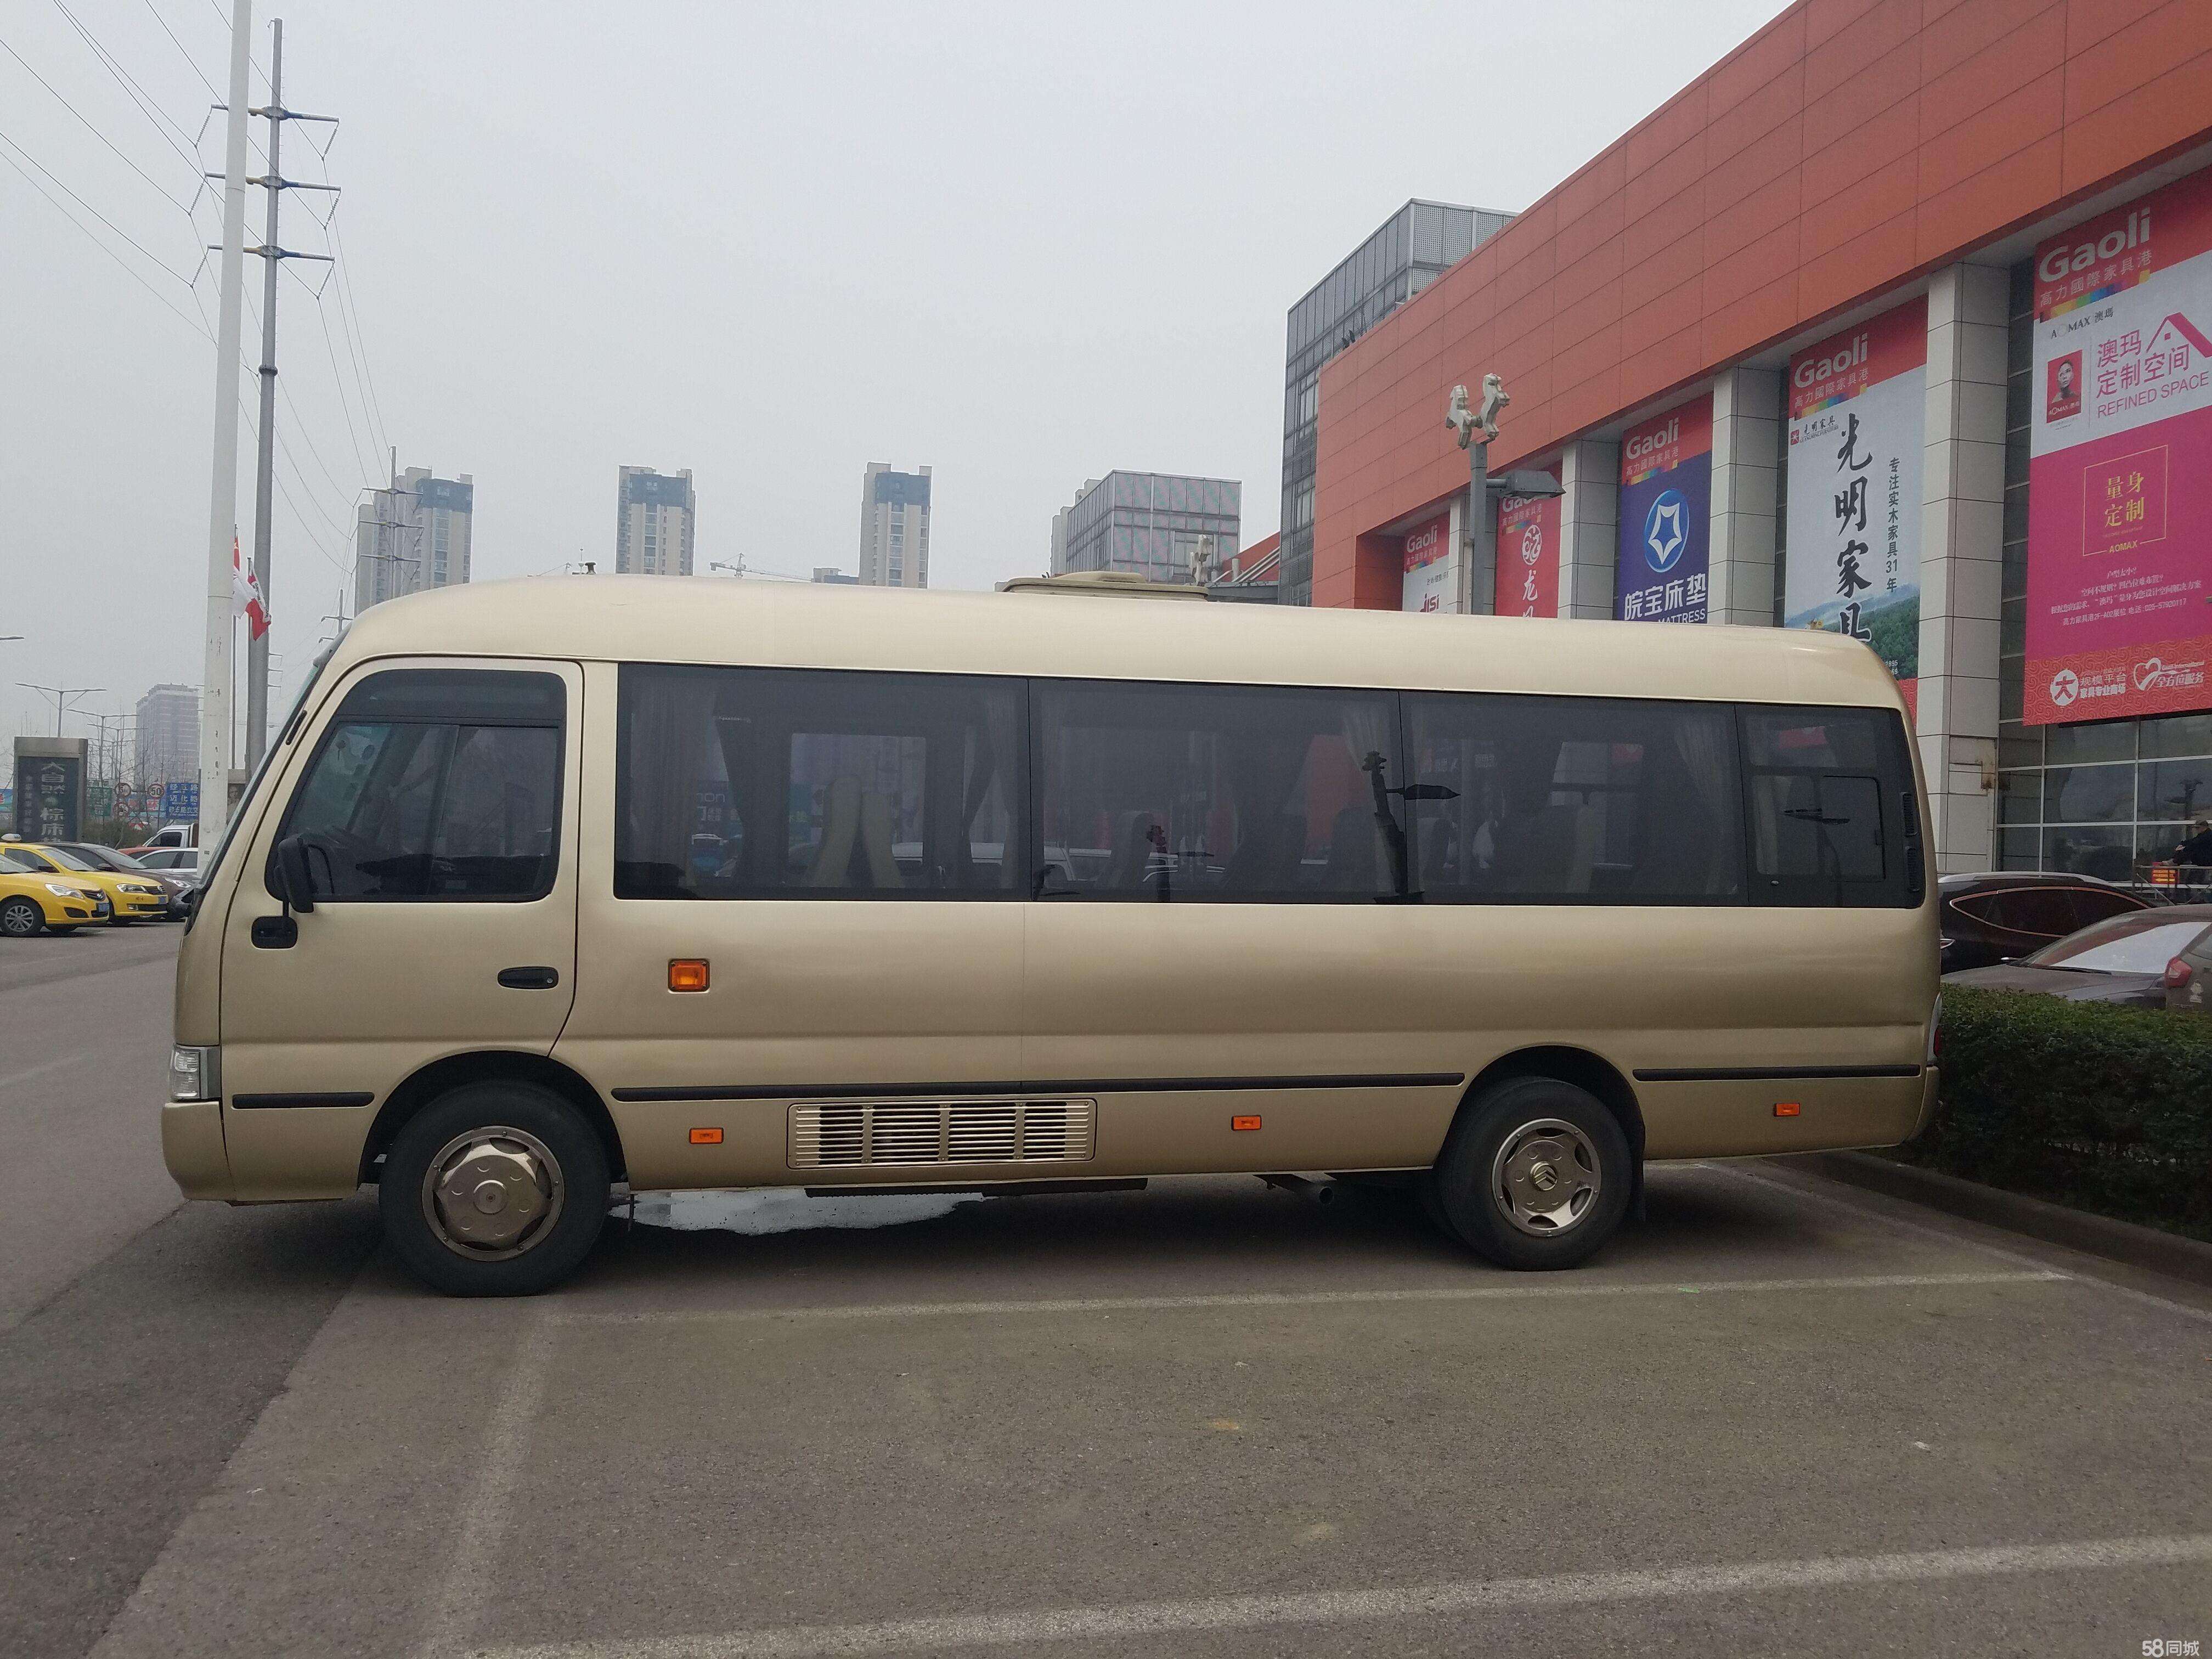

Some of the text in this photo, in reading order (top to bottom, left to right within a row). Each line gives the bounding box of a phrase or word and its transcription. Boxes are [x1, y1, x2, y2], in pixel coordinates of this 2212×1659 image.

[2039, 207, 2151, 283] Gaoli
[1795, 333, 1868, 388] Gaoli
[2096, 343, 2190, 399] 定制空间
[2097, 330, 2142, 368] 澳玛
[2098, 371, 2209, 419] REFINED SPACE
[1626, 417, 1679, 460] Gaoli
[2106, 471, 2145, 500] 量身
[1885, 458, 1900, 592] 专注实木家具31年
[2104, 496, 2145, 528] 定制
[1407, 524, 1438, 553] Gaoli
